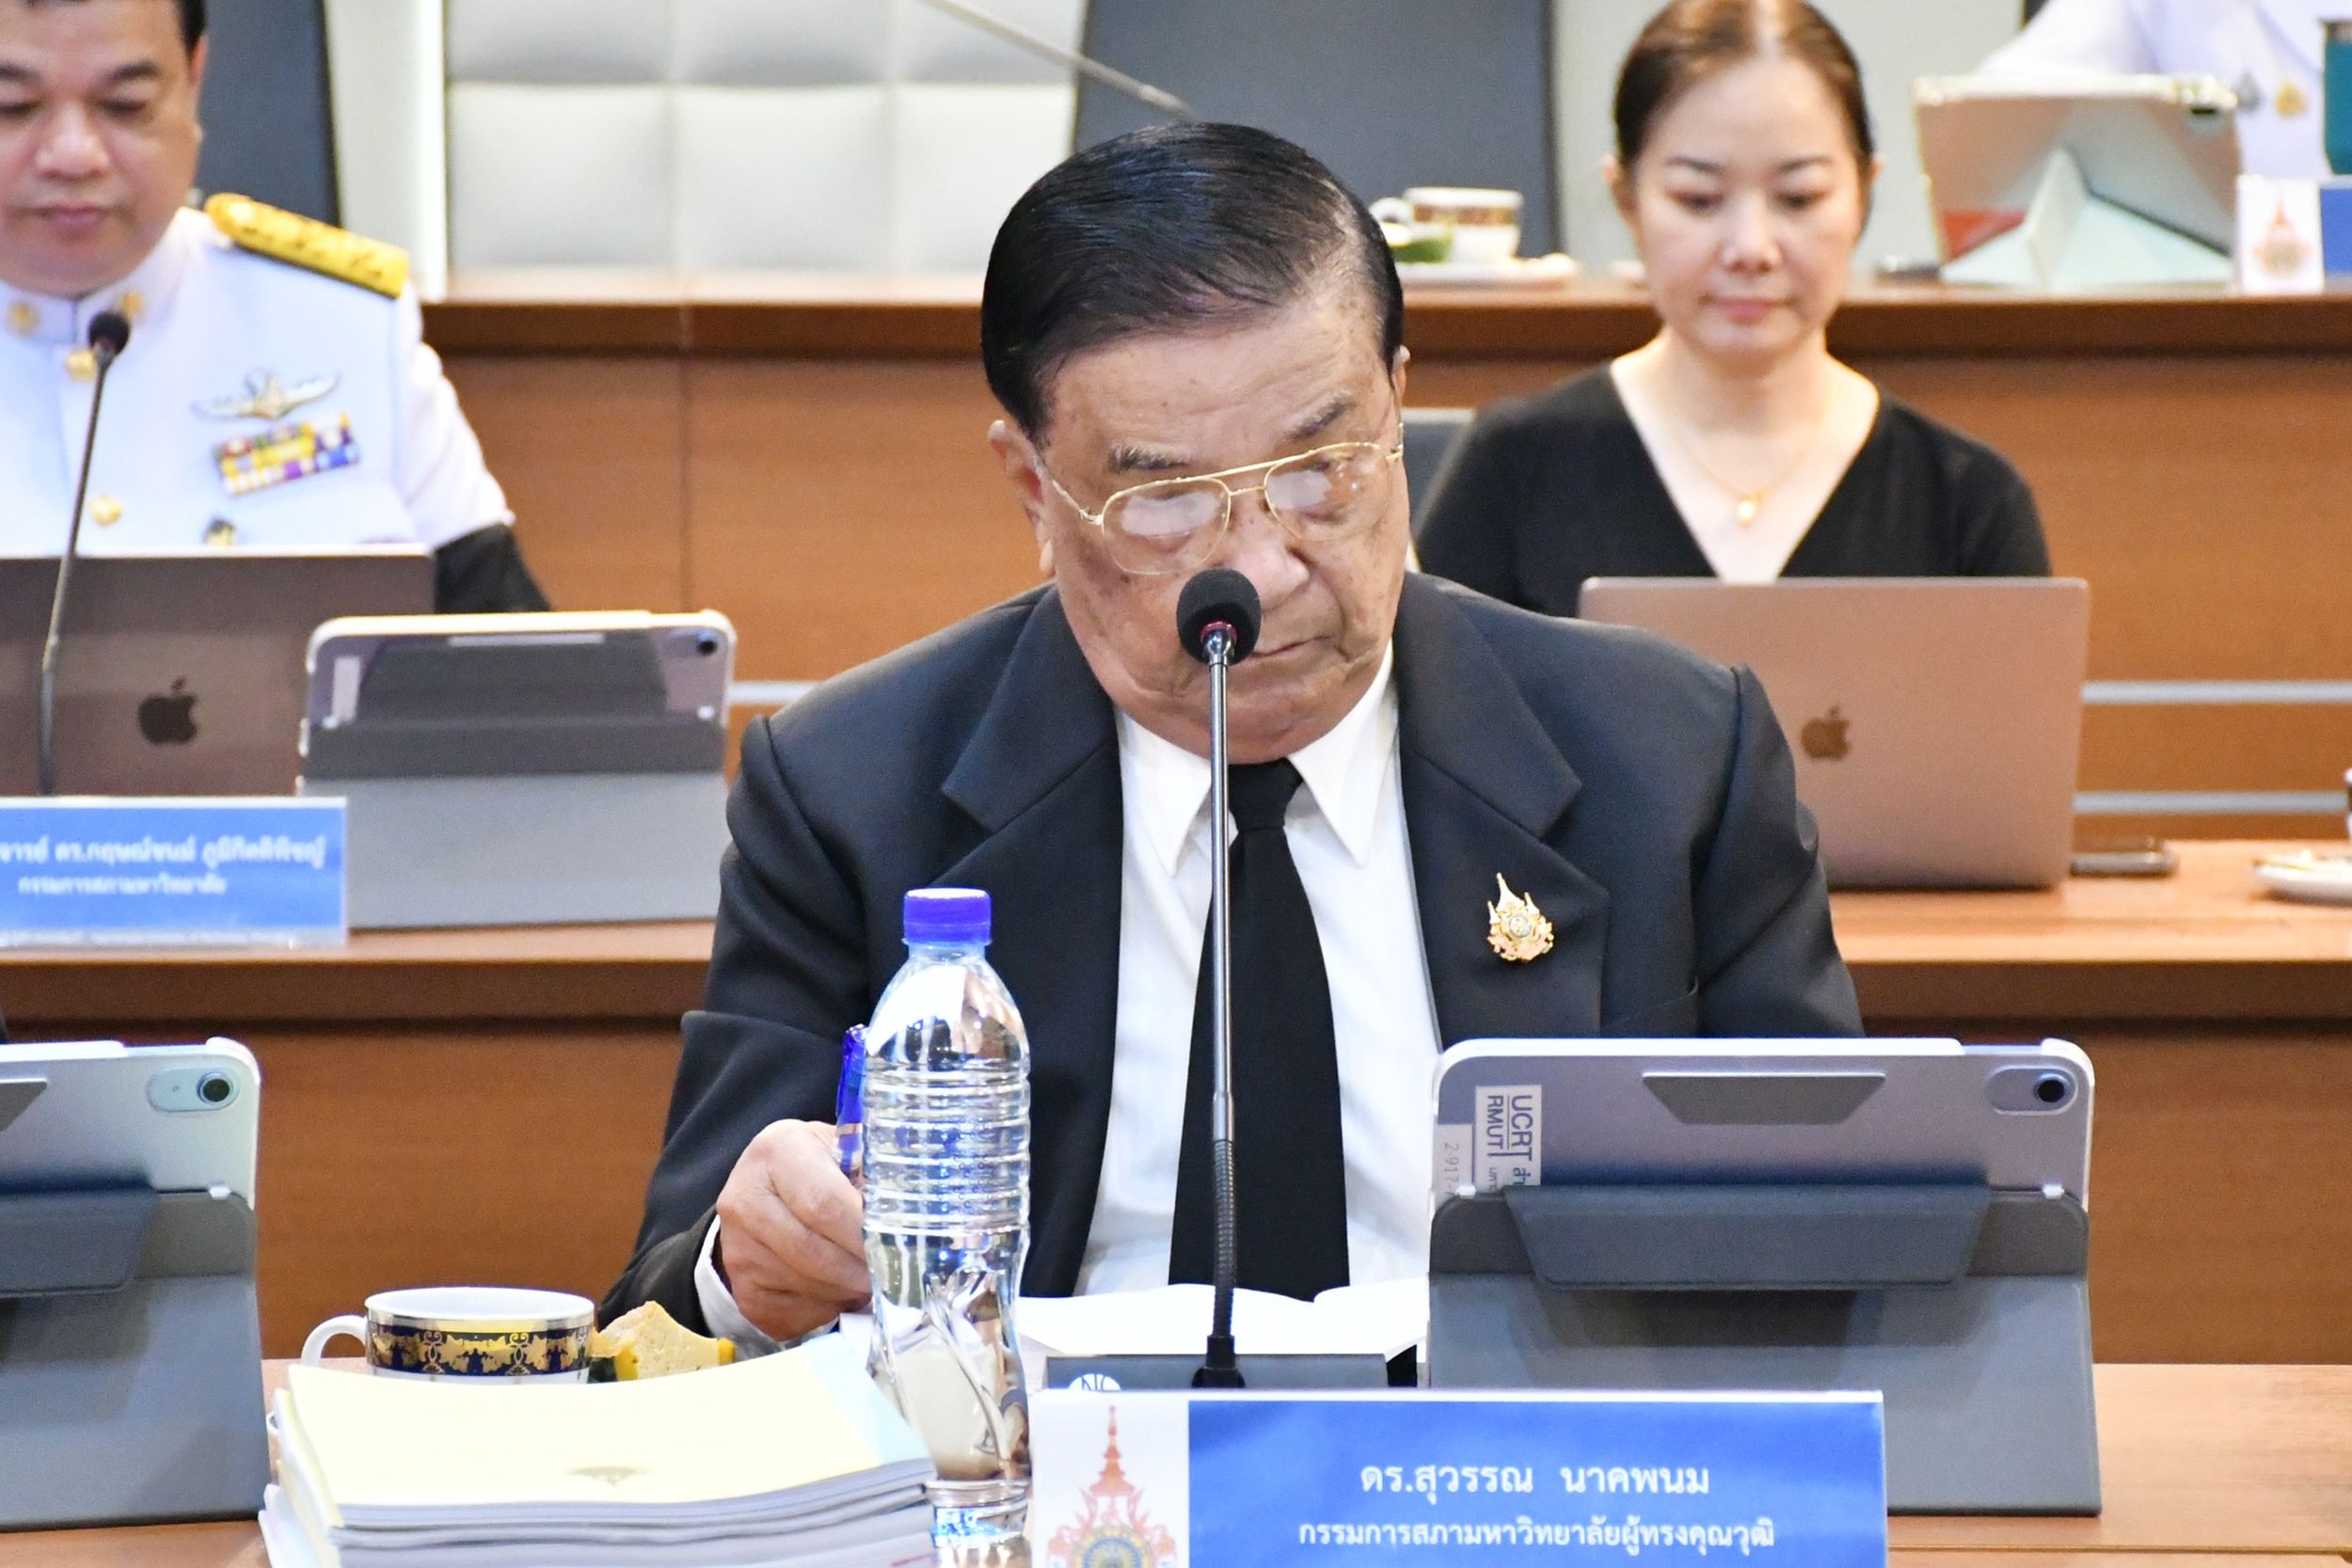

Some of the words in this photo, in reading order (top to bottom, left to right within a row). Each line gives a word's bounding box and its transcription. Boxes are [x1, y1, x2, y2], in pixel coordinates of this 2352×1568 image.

[1511, 1095, 1534, 1162] UCRT
[1360, 1464, 1534, 1506] ดร.สุวรรณ
[1559, 1465, 1710, 1495] นาคพนม
[1298, 1513, 1775, 1557] กรรมการสภามหาวิทยาลัยผู้ทรงคุณวุฒิ
